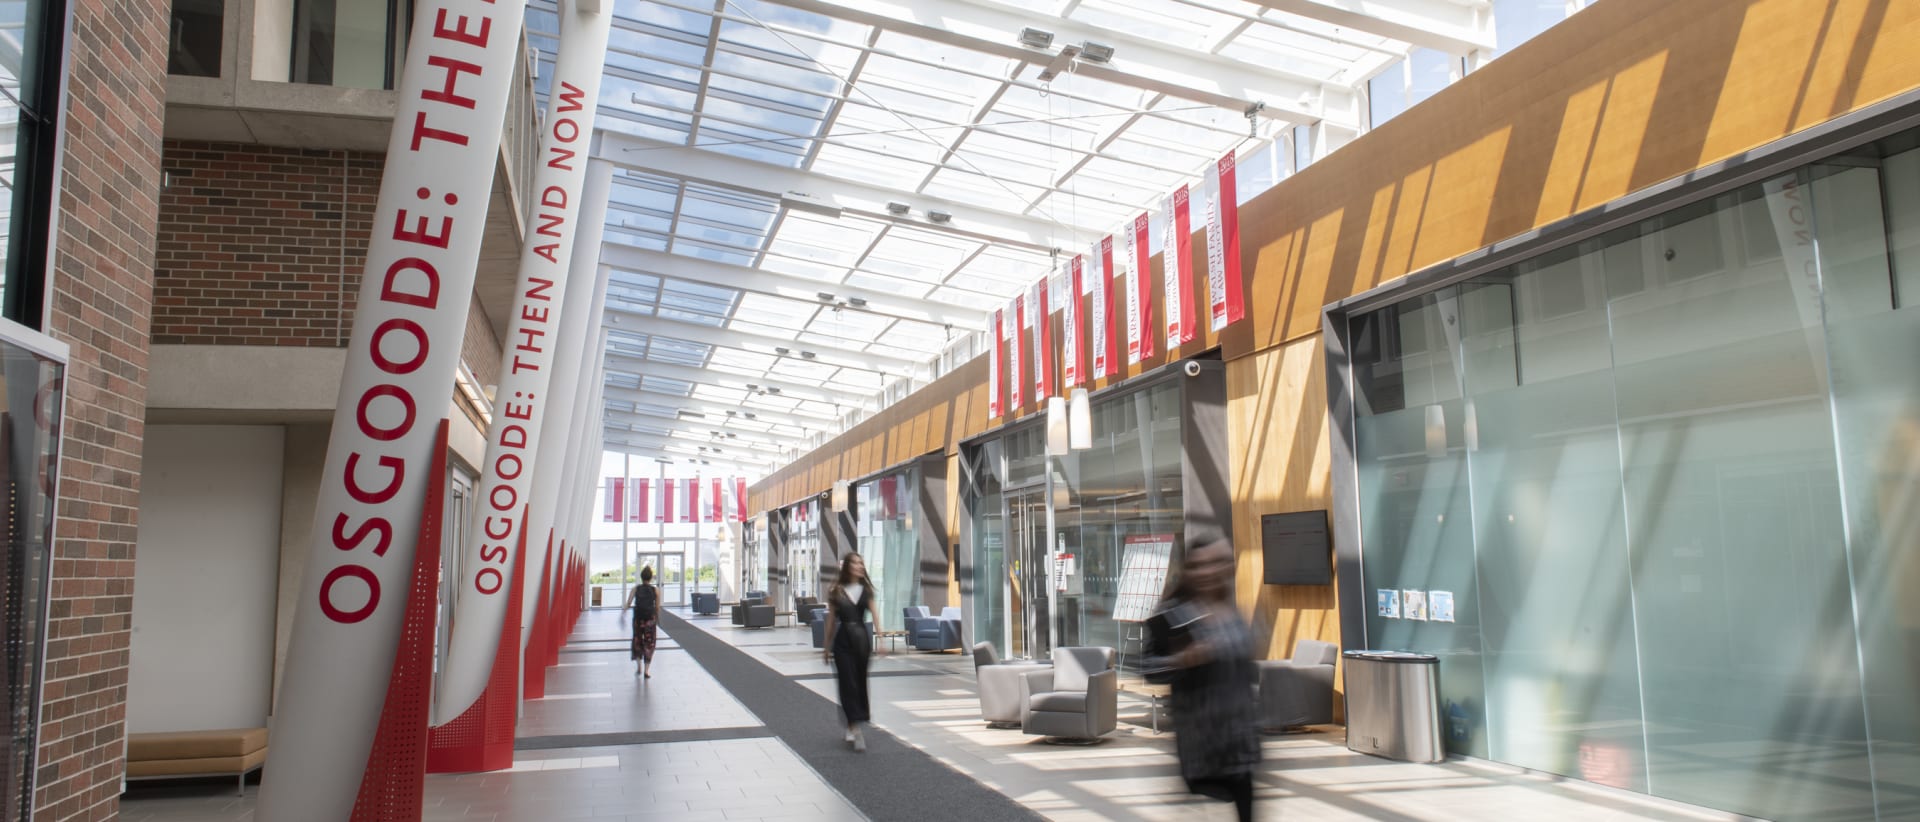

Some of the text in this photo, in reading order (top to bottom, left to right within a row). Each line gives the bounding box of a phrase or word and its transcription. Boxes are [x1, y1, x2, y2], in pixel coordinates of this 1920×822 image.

[319, 0, 496, 624] OSGOODE: THE
[475, 81, 586, 595] OSGOODE: THEN AND NOW
[1207, 200, 1217, 303] WALSH FAMILY
[1215, 225, 1225, 300] LAW MOOT
